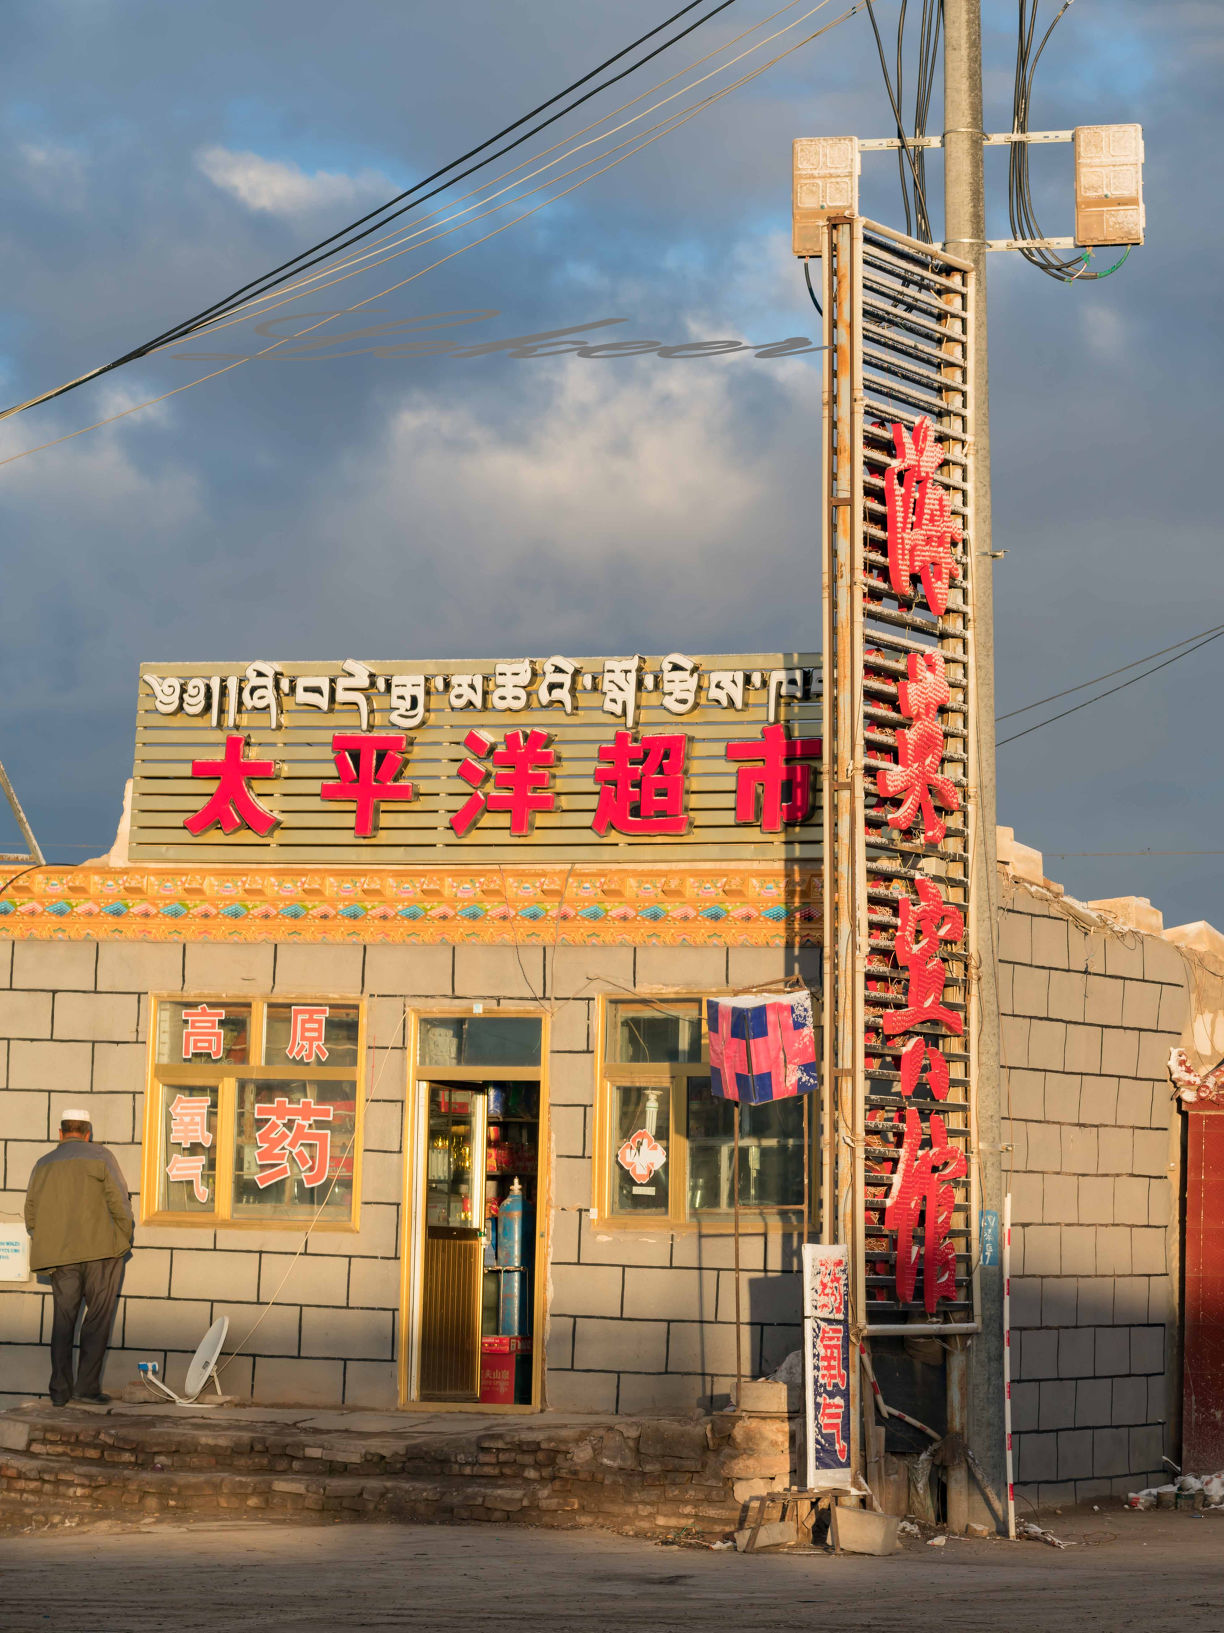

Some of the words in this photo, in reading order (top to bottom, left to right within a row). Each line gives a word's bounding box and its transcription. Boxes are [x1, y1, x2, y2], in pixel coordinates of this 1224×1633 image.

[183, 722, 823, 840] 太平洋超市
[182, 1004, 329, 1062] 高原
[166, 1095, 213, 1203] 氧气
[254, 1098, 333, 1189] 药
